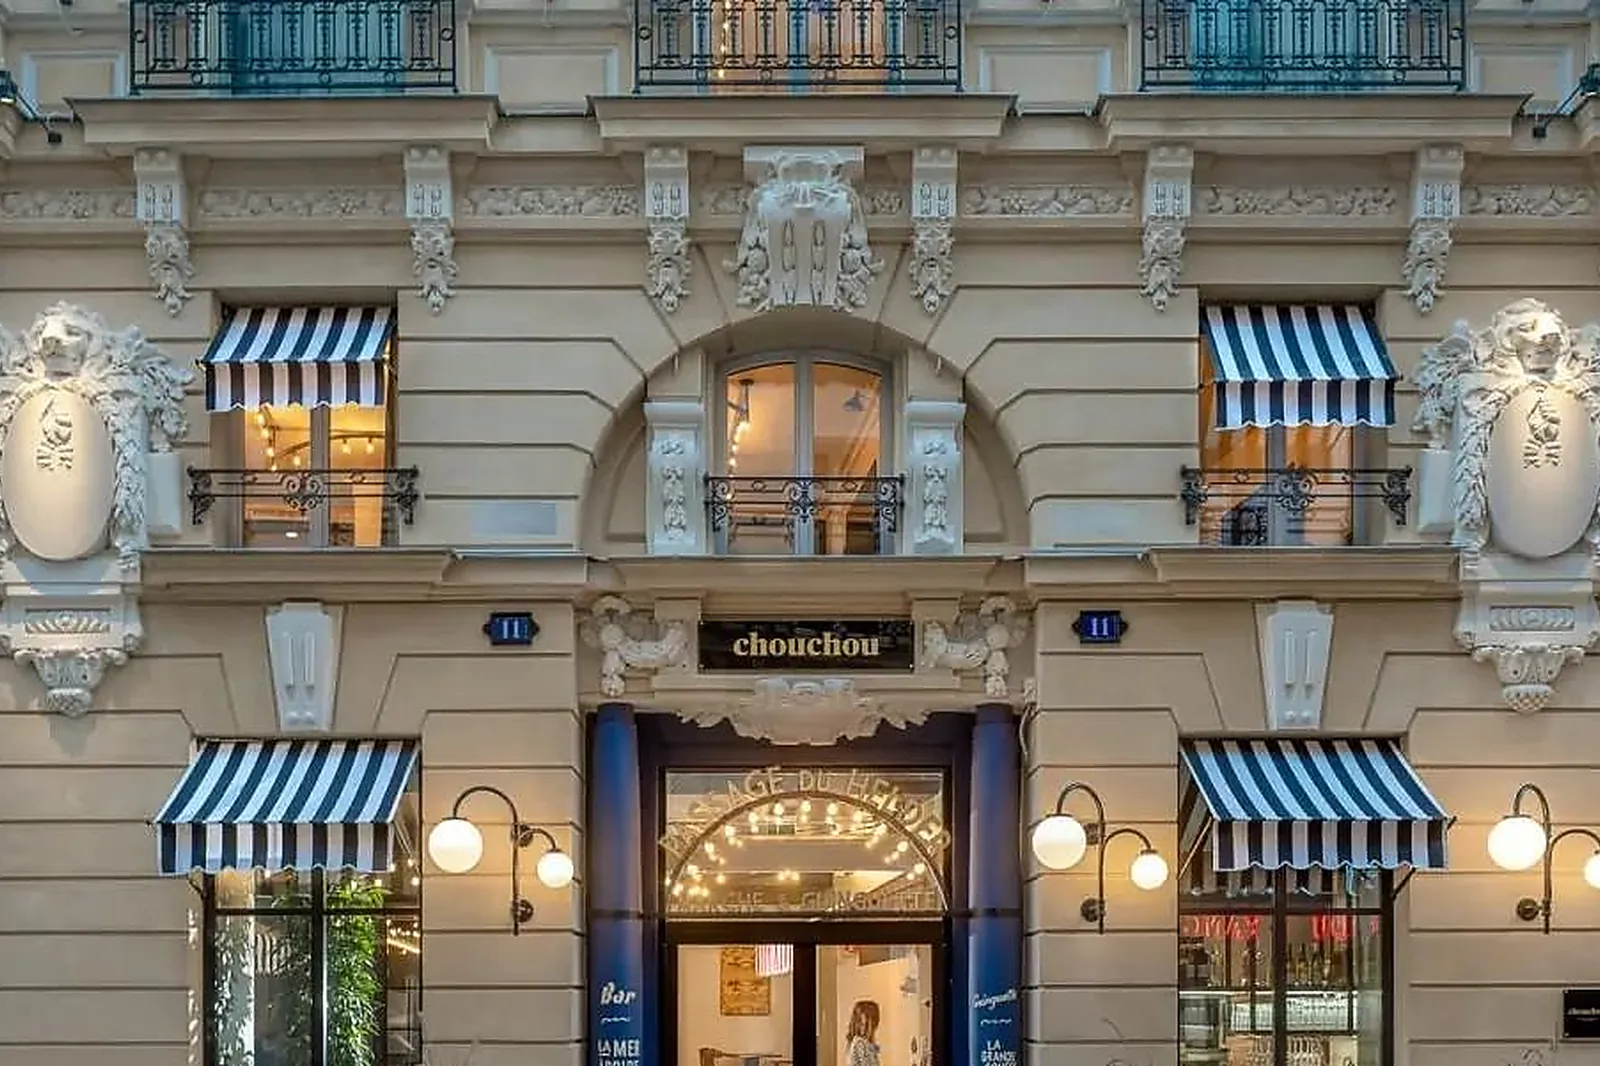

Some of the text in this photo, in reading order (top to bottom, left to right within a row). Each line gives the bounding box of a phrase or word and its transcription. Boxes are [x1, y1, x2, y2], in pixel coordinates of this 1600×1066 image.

[502, 619, 520, 639] 11
[1091, 617, 1109, 636] 11
[733, 632, 880, 656] chouchou
[799, 768, 830, 792] DU
[600, 981, 637, 1005] Bar
